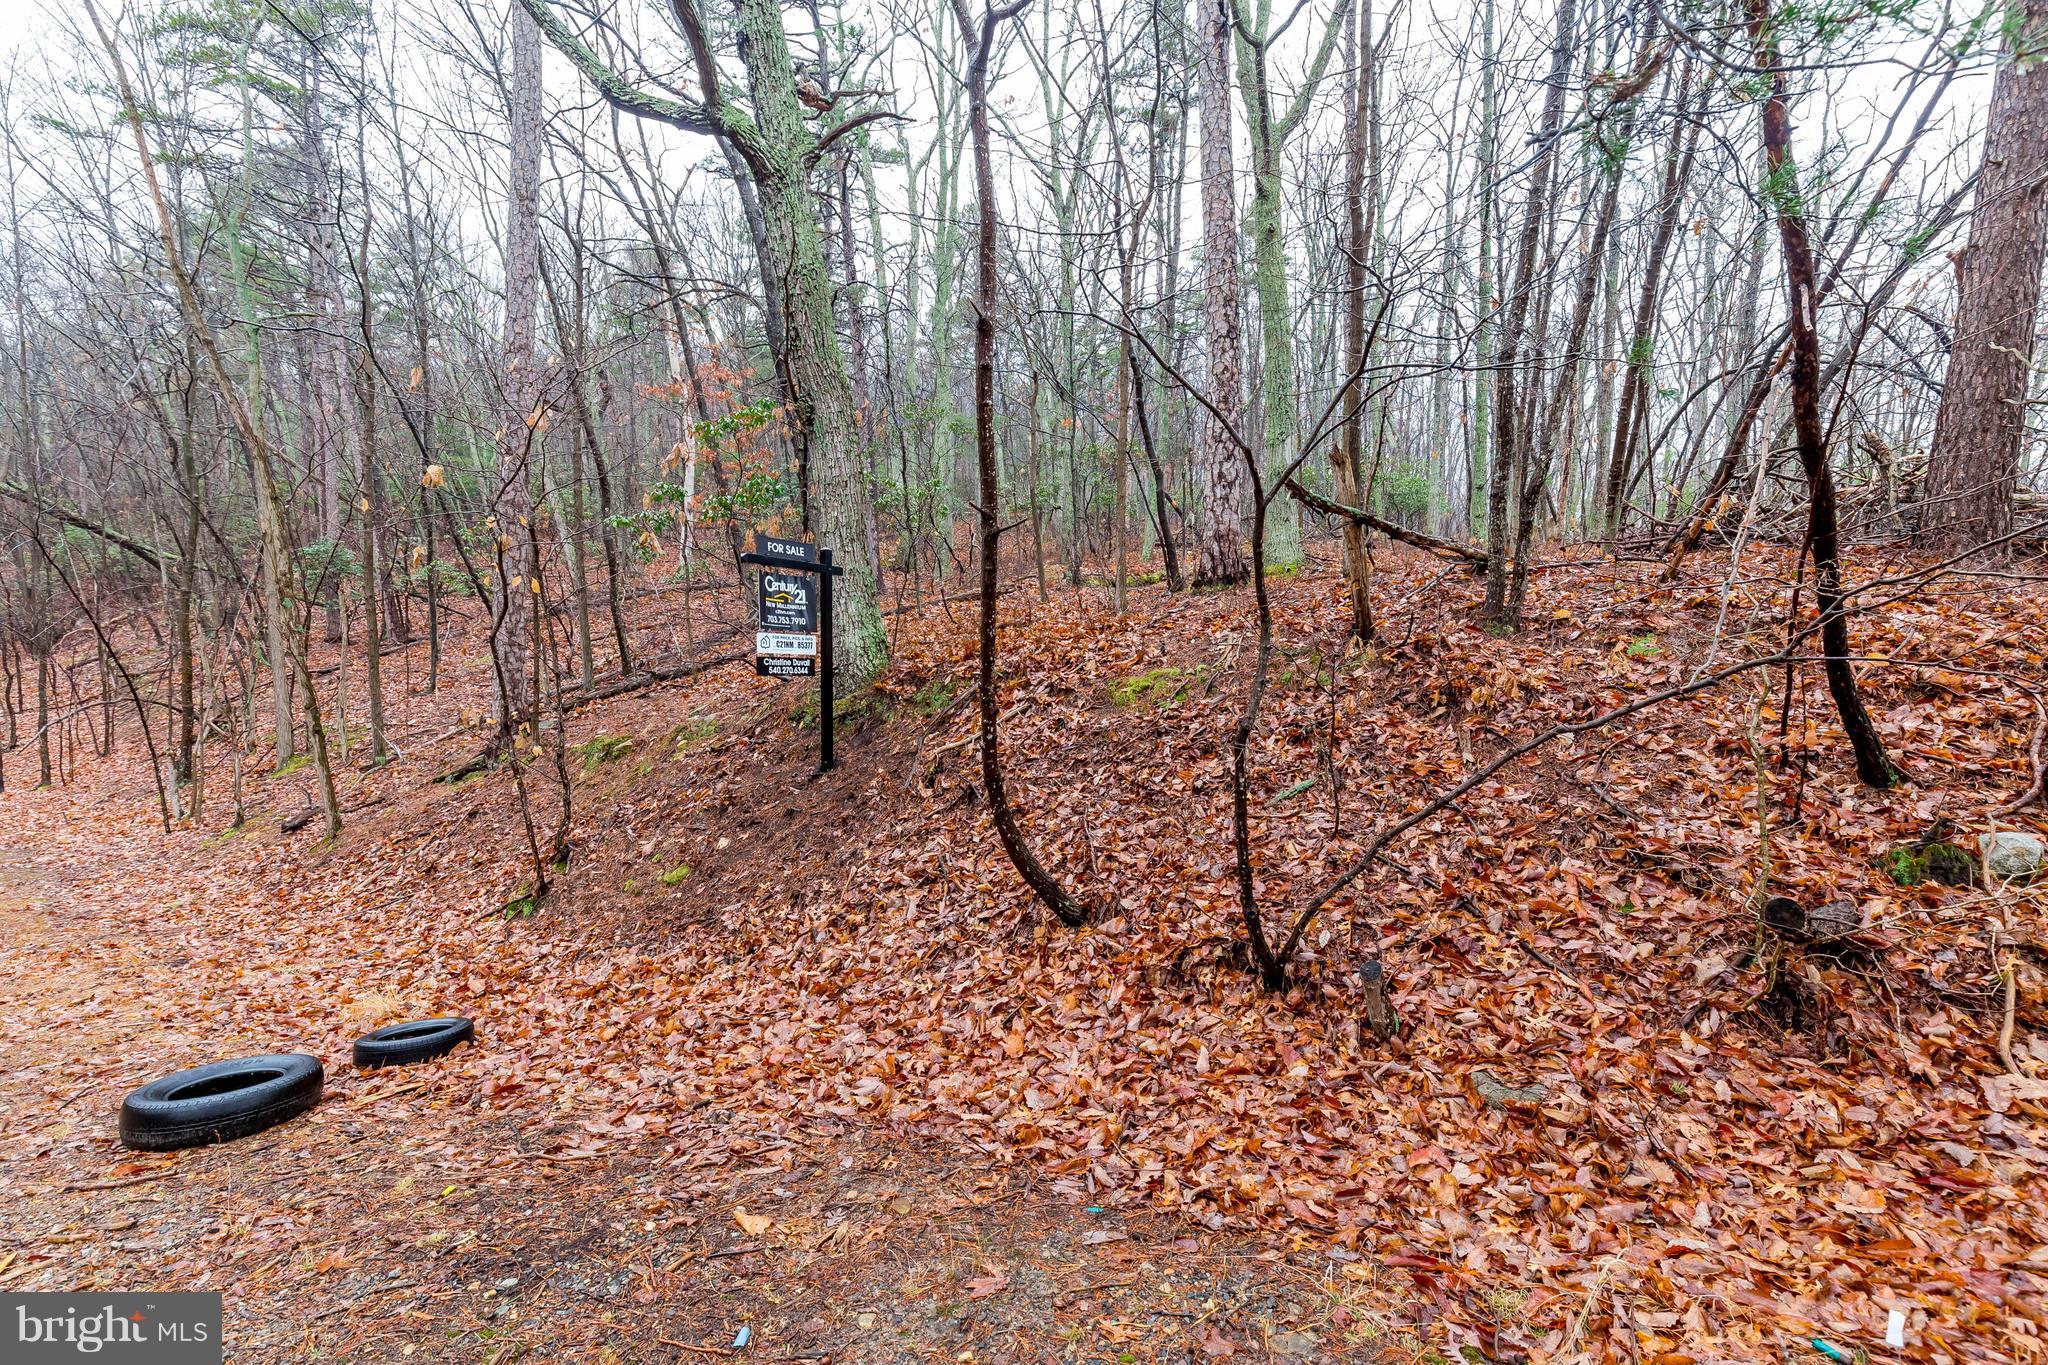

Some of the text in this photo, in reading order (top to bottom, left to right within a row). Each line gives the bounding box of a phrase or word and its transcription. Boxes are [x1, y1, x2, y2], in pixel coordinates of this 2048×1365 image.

[767, 542, 805, 556] FOR SALE
[765, 575, 798, 594] Century
[795, 590, 806, 604] 21
[767, 615, 806, 625] 703.753.7910
[776, 640, 794, 648] C21NM
[763, 658, 791, 666] Christine
